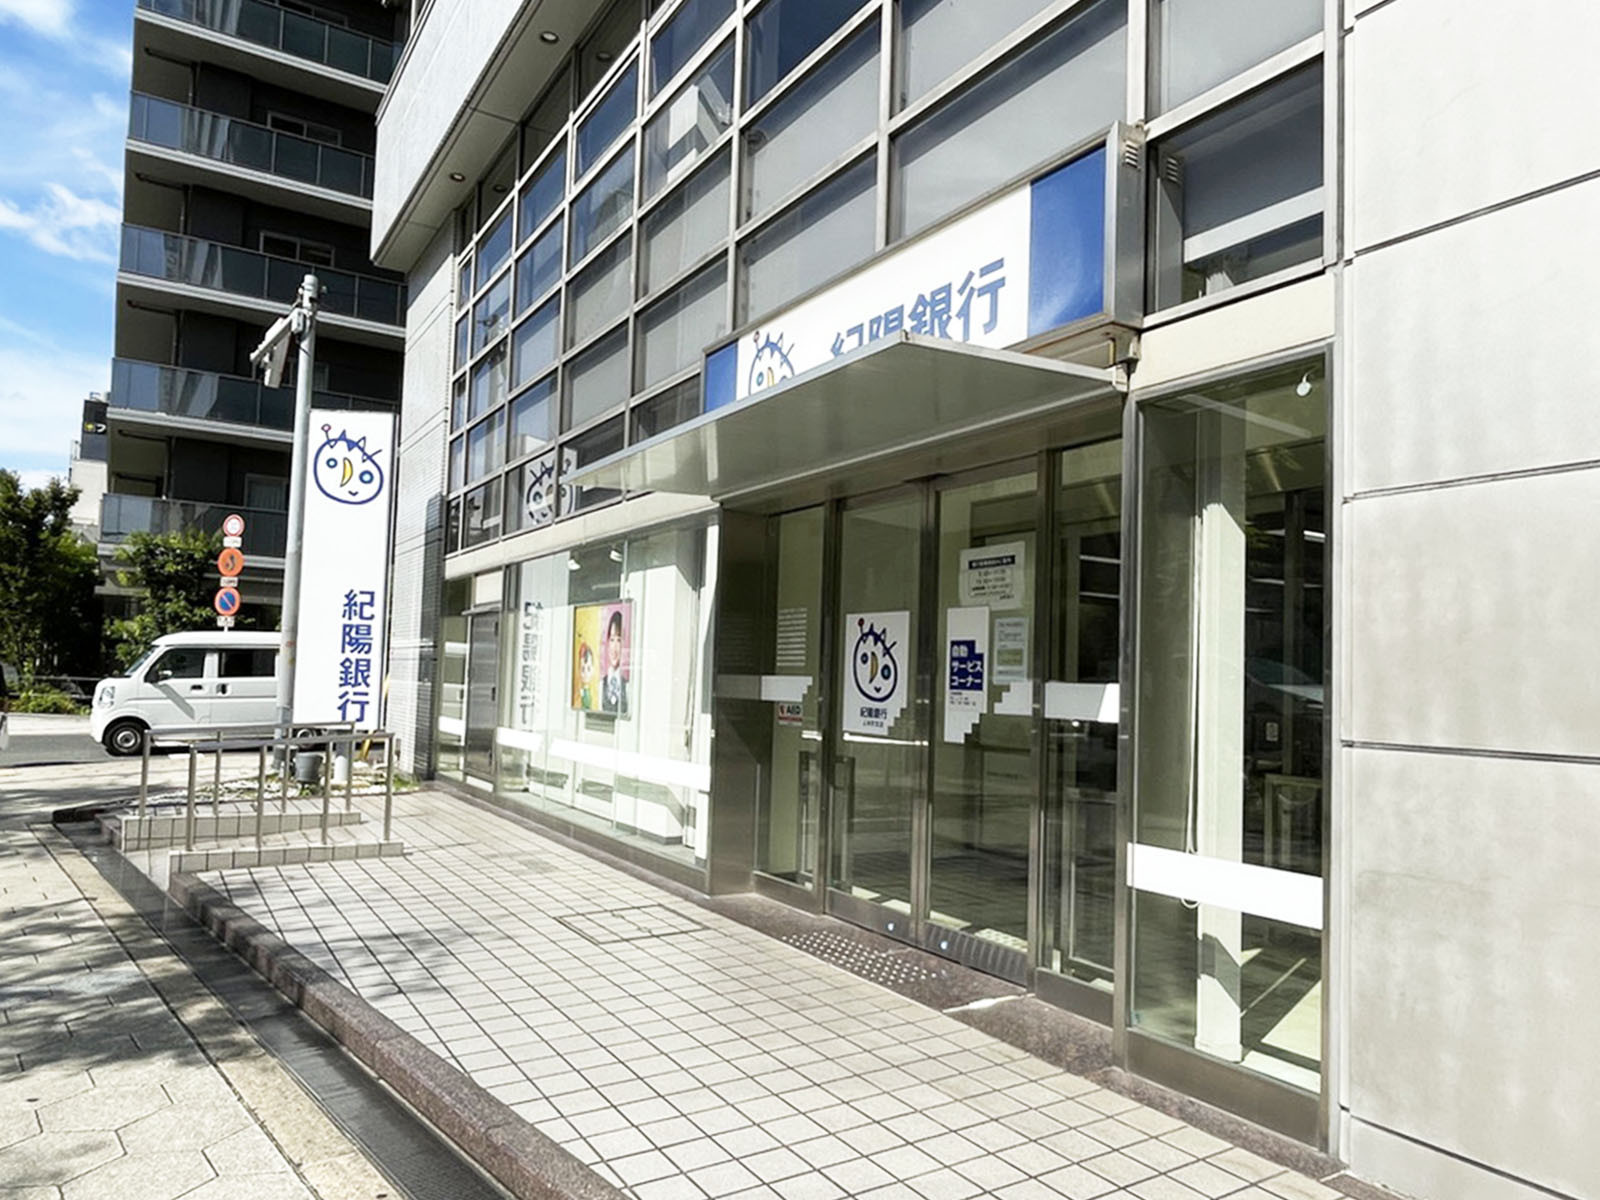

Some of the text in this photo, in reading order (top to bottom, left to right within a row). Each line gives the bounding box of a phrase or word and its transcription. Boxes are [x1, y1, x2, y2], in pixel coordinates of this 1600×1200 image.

[337, 589, 375, 722] 紀陽銀行
[951, 660, 983, 673] サービス
[951, 674, 982, 687] コーナー
